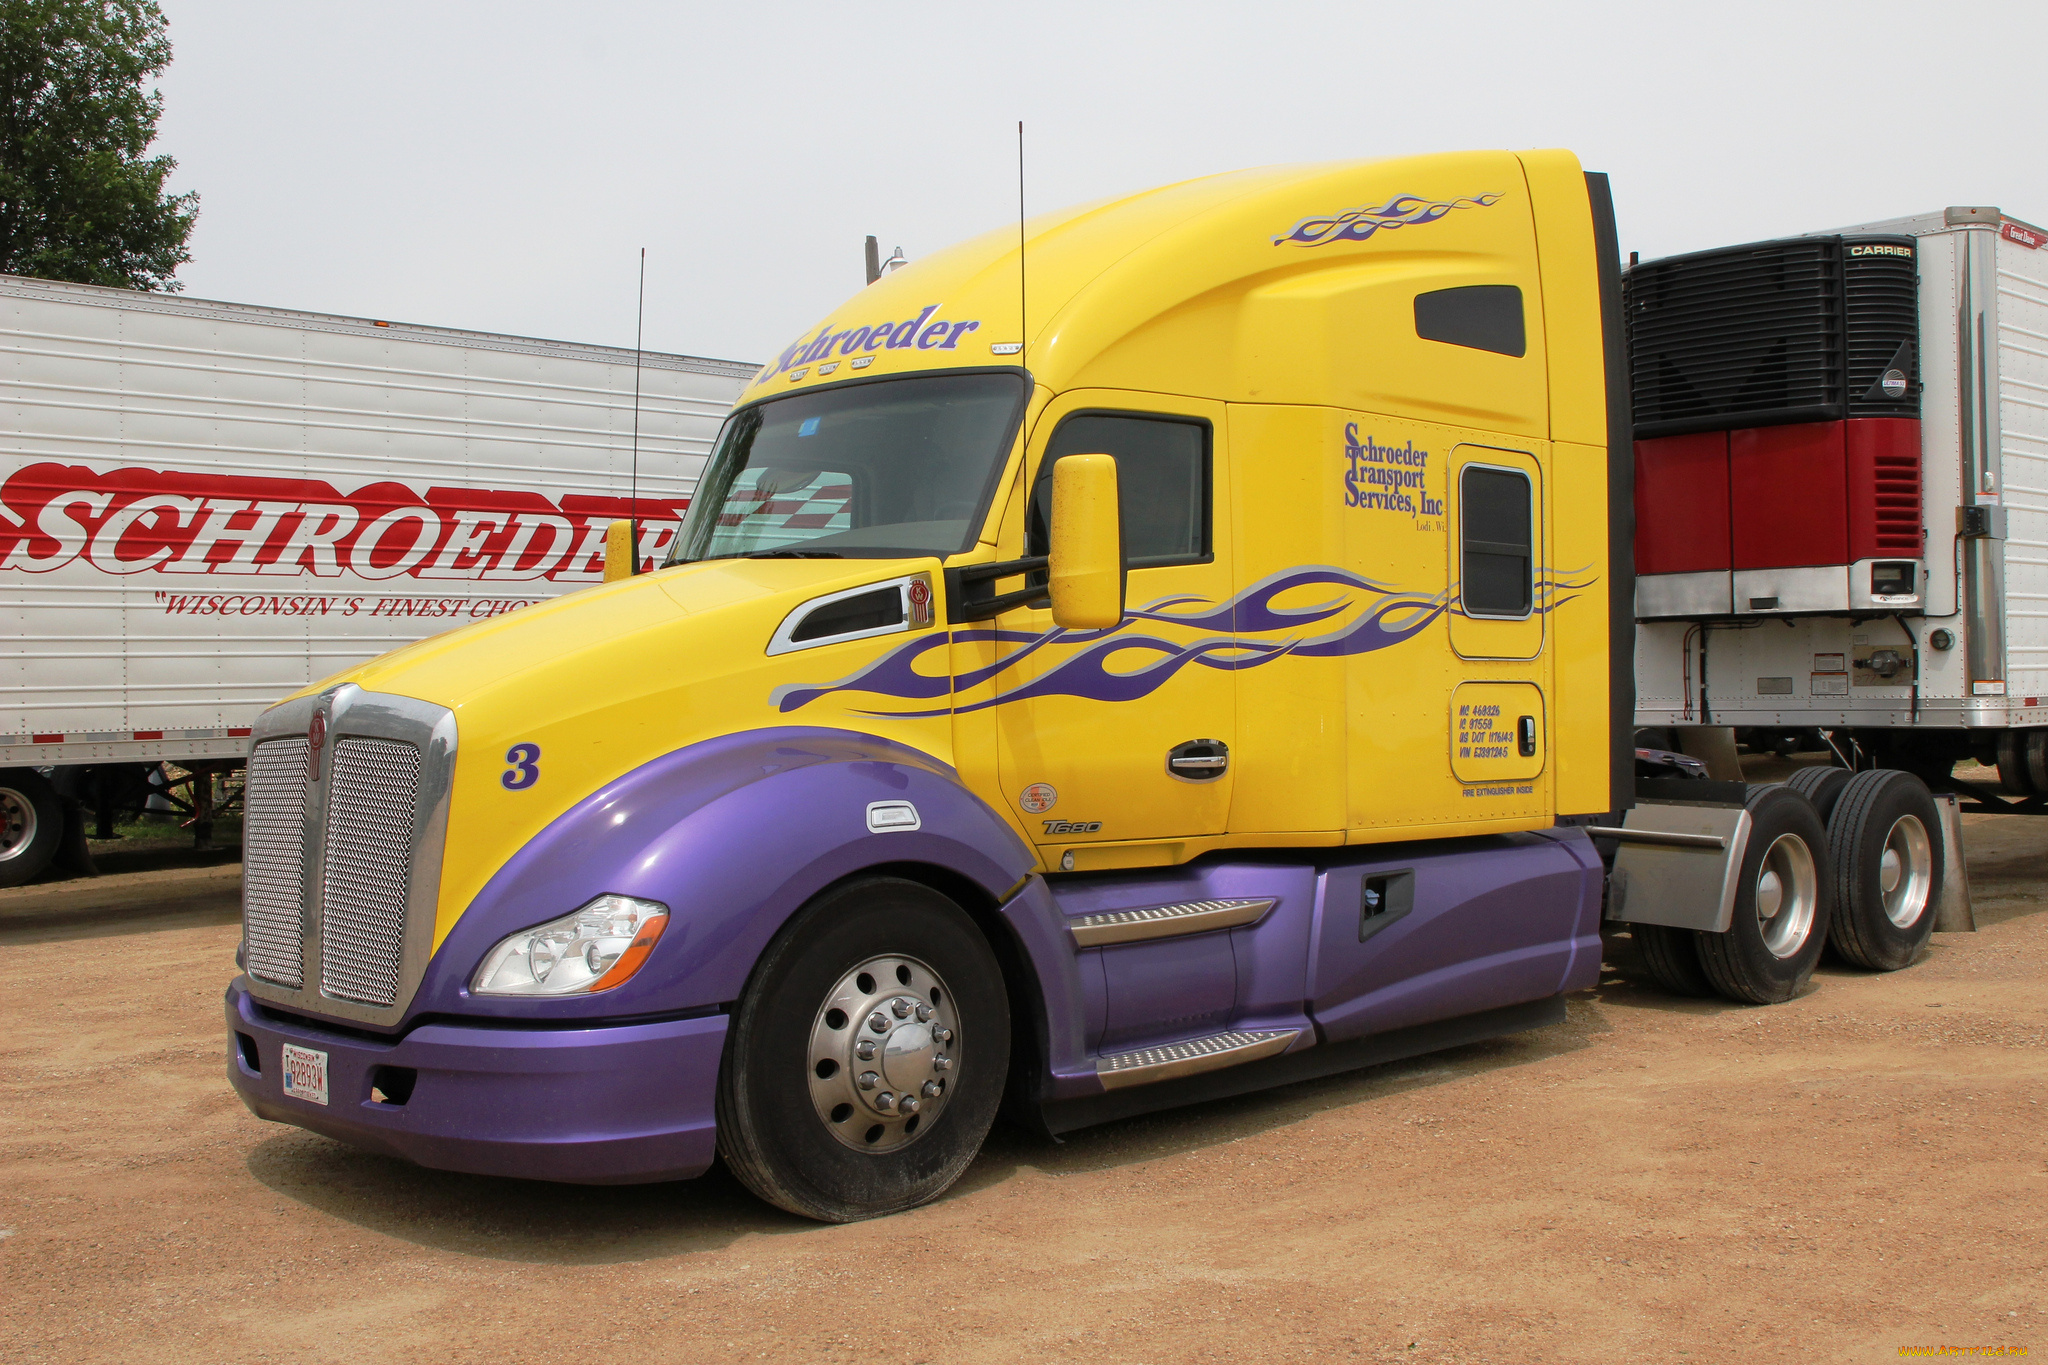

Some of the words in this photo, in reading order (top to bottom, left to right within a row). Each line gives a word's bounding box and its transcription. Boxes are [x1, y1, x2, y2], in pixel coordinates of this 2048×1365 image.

[1850, 245, 1911, 257] CARRIER
[755, 302, 981, 387] Schroeder
[1344, 422, 1428, 467] Schroeder
[1344, 445, 1425, 494] Transport
[1344, 469, 1416, 519] Services,
[1420, 490, 1443, 516] Inc
[368, 598, 469, 618] FINEST
[1459, 731, 1469, 743] US
[1471, 731, 1486, 743] DOT
[500, 741, 542, 791] 3
[1463, 788, 1475, 797] FIRE
[1476, 786, 1514, 797] EXTINGUISHER
[1516, 785, 1533, 795] INSIDE
[1043, 820, 1102, 835] T680
